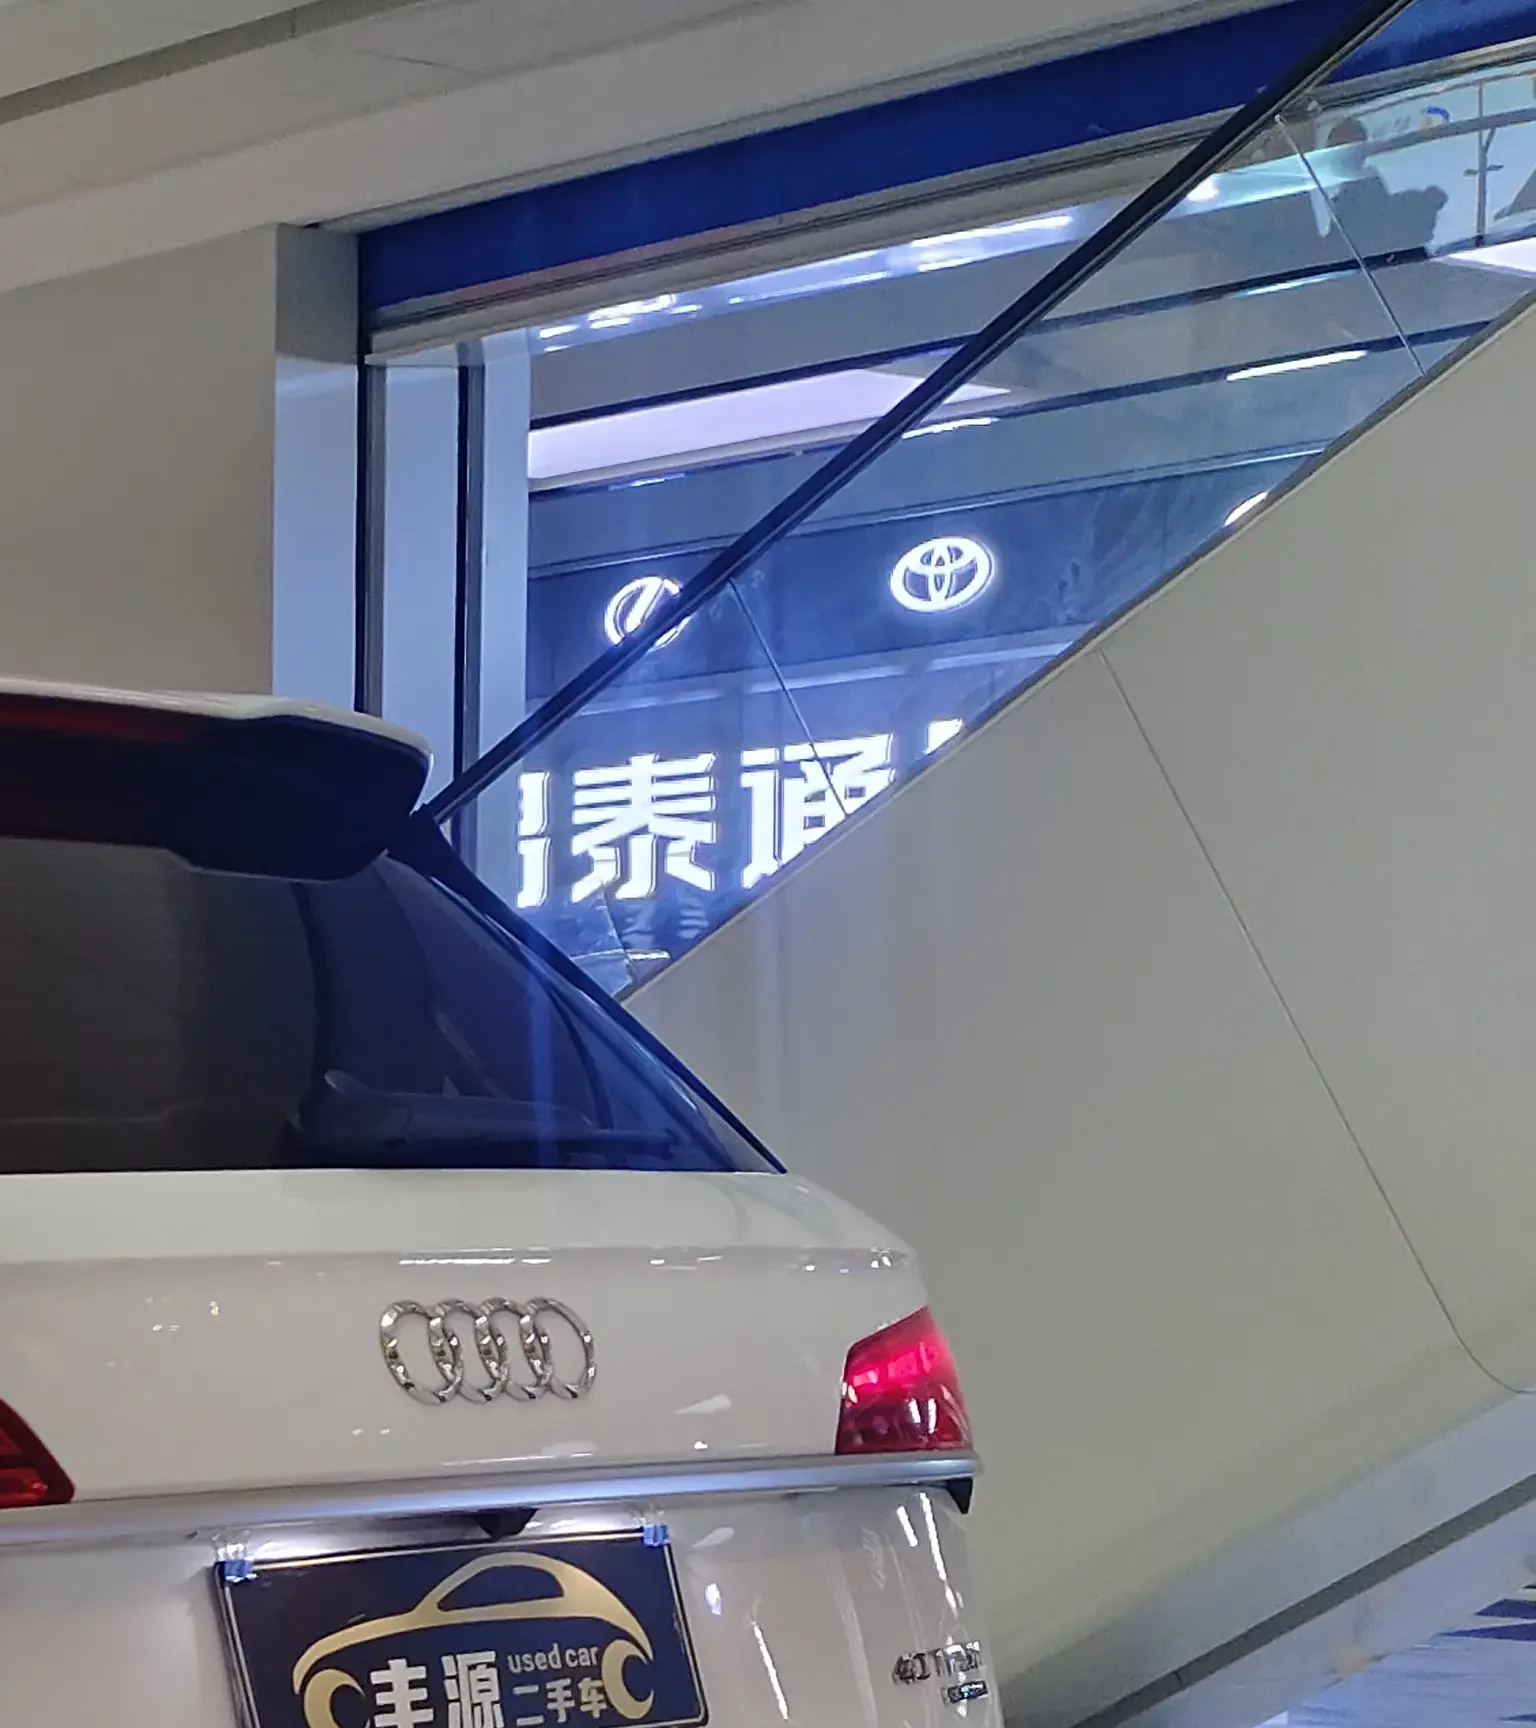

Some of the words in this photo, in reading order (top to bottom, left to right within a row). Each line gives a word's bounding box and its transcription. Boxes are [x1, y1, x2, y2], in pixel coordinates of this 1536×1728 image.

[516, 718, 964, 908] 泰通
[507, 1644, 559, 1674] used
[566, 1644, 601, 1669] car
[511, 1676, 610, 1727] 二手车
